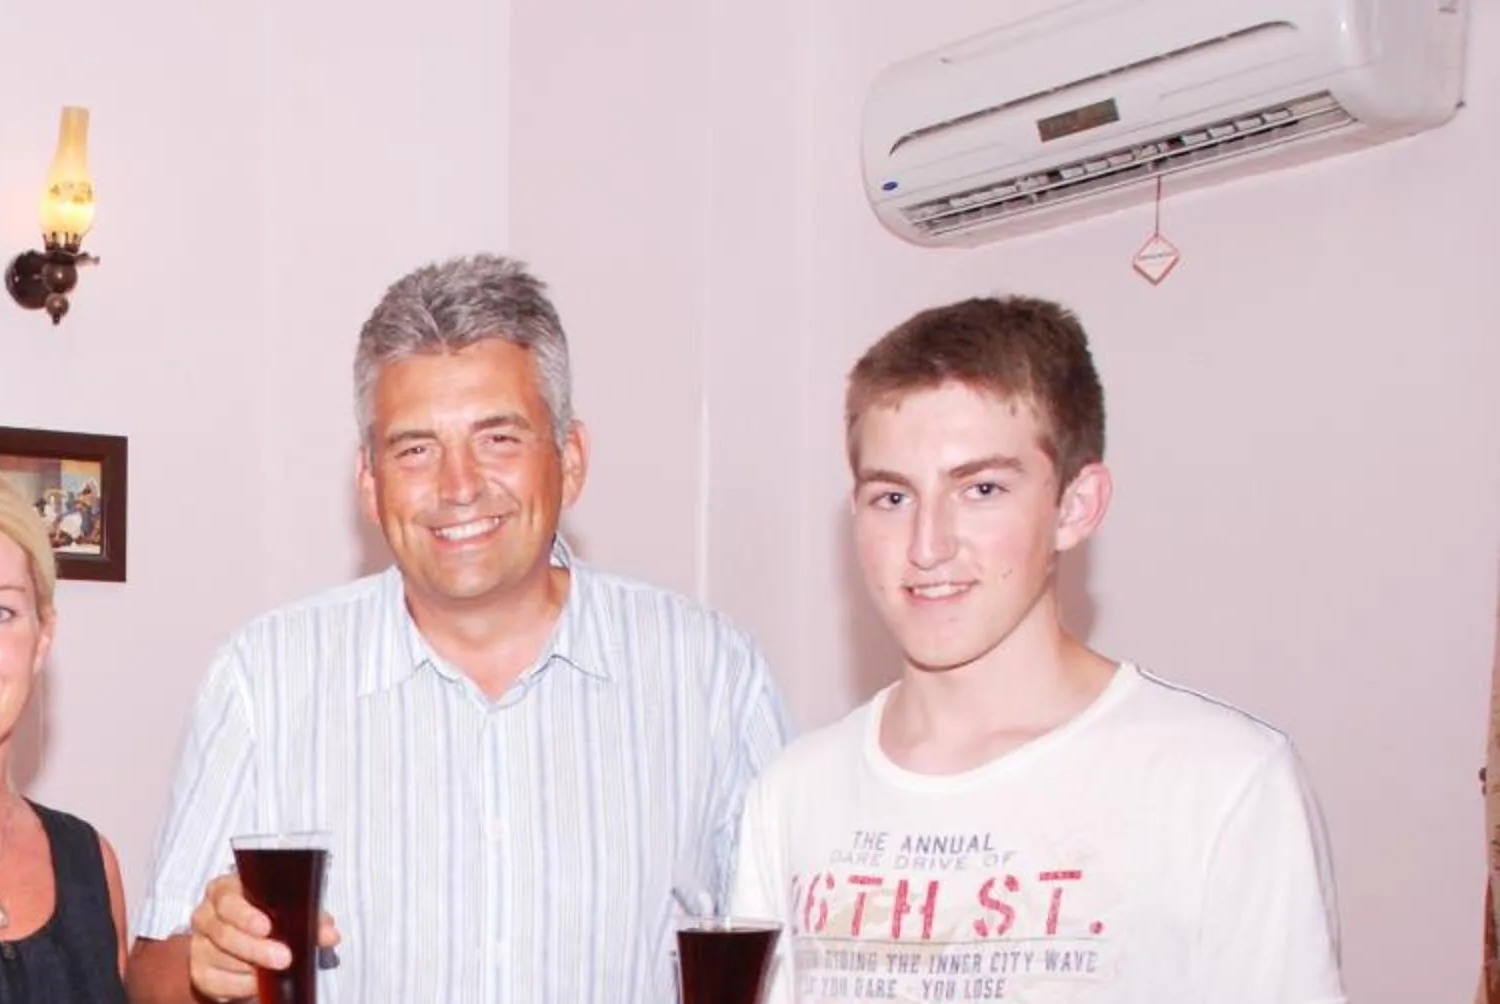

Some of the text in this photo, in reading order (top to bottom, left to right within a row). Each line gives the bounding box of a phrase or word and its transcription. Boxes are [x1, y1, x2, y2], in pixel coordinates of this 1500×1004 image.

[852, 830, 994, 854] THE ANNUAL
[894, 854, 969, 871] DRIVE
[983, 850, 1016, 868] OF
[973, 870, 1104, 938] ST.
[886, 952, 921, 974] THE
[929, 951, 983, 975] INNER
[990, 951, 1034, 974] CITY
[1045, 949, 1098, 973] WAVE
[855, 977, 897, 999] DARE
[922, 979, 956, 1001] YOU
[963, 978, 1007, 1000] LOSE
